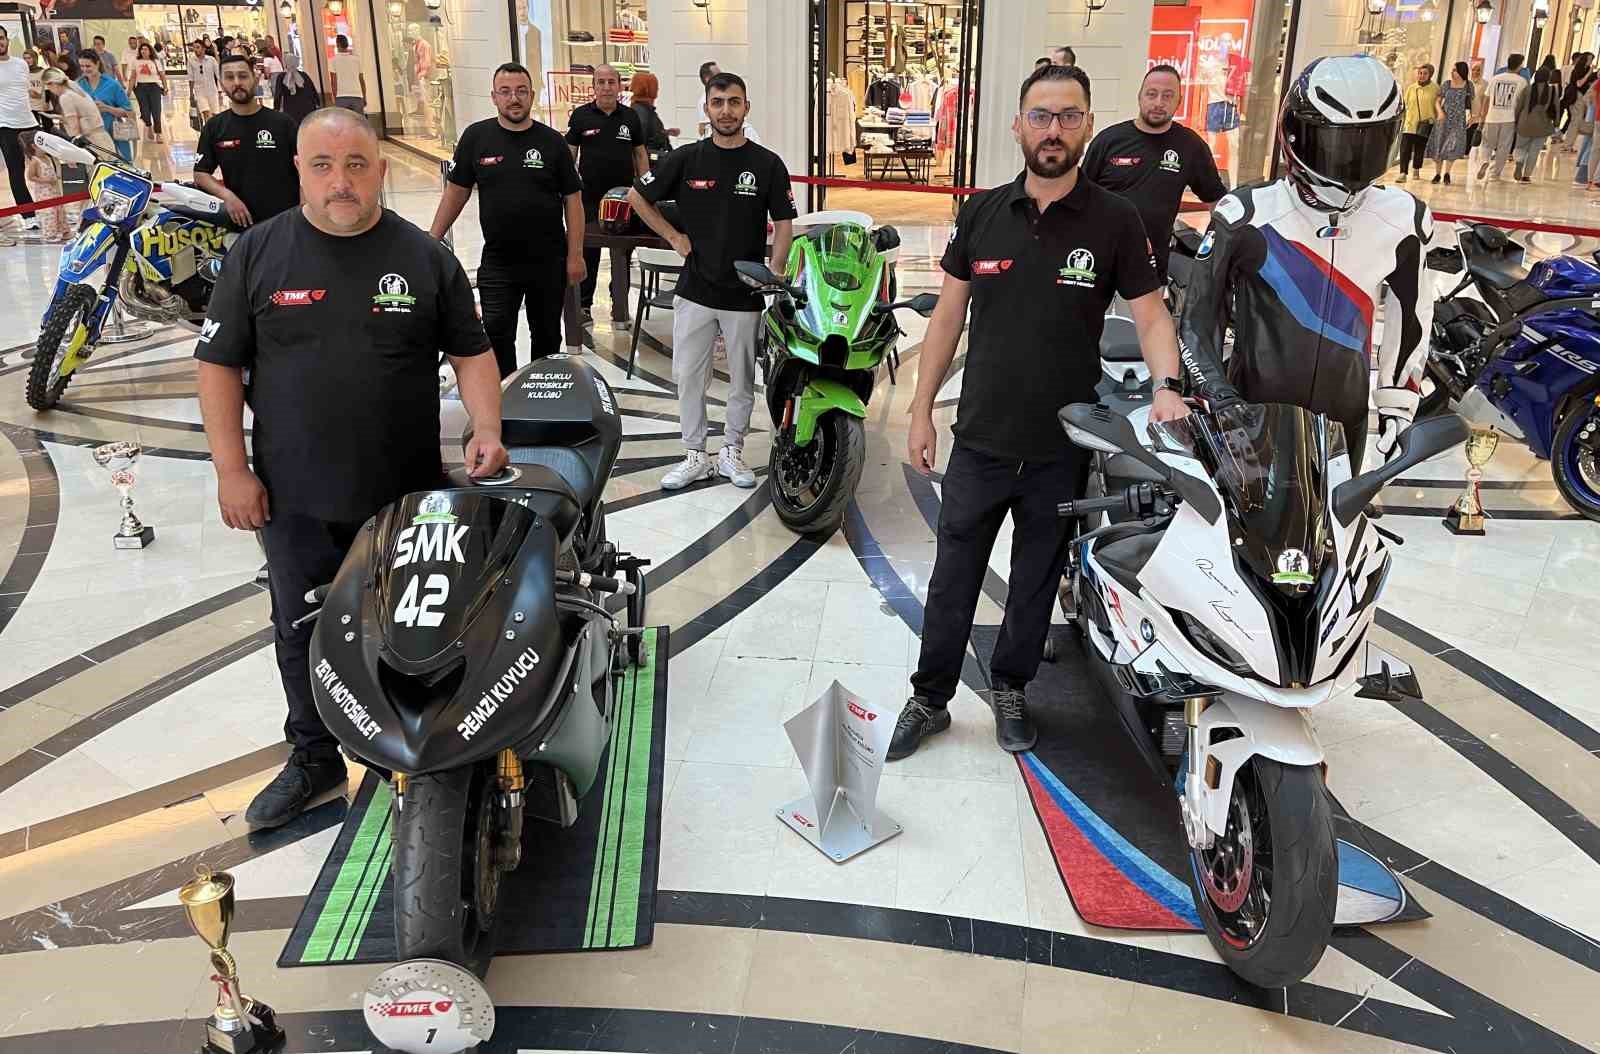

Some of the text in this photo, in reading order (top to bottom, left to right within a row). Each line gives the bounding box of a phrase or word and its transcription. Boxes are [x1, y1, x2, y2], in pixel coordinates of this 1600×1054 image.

[979, 262, 998, 270] TMF
[284, 292, 308, 300] TMF
[528, 372, 572, 382] SELÇUKLU
[527, 390, 563, 399] KULÜBÜ
[393, 523, 470, 569] SMK
[394, 574, 450, 627] 42
[314, 658, 382, 741] ZEVK MOTOSİKLET
[456, 647, 541, 741] REMZİ KUYUCU
[396, 1003, 428, 1013] TMF
[425, 1028, 438, 1044] 1
